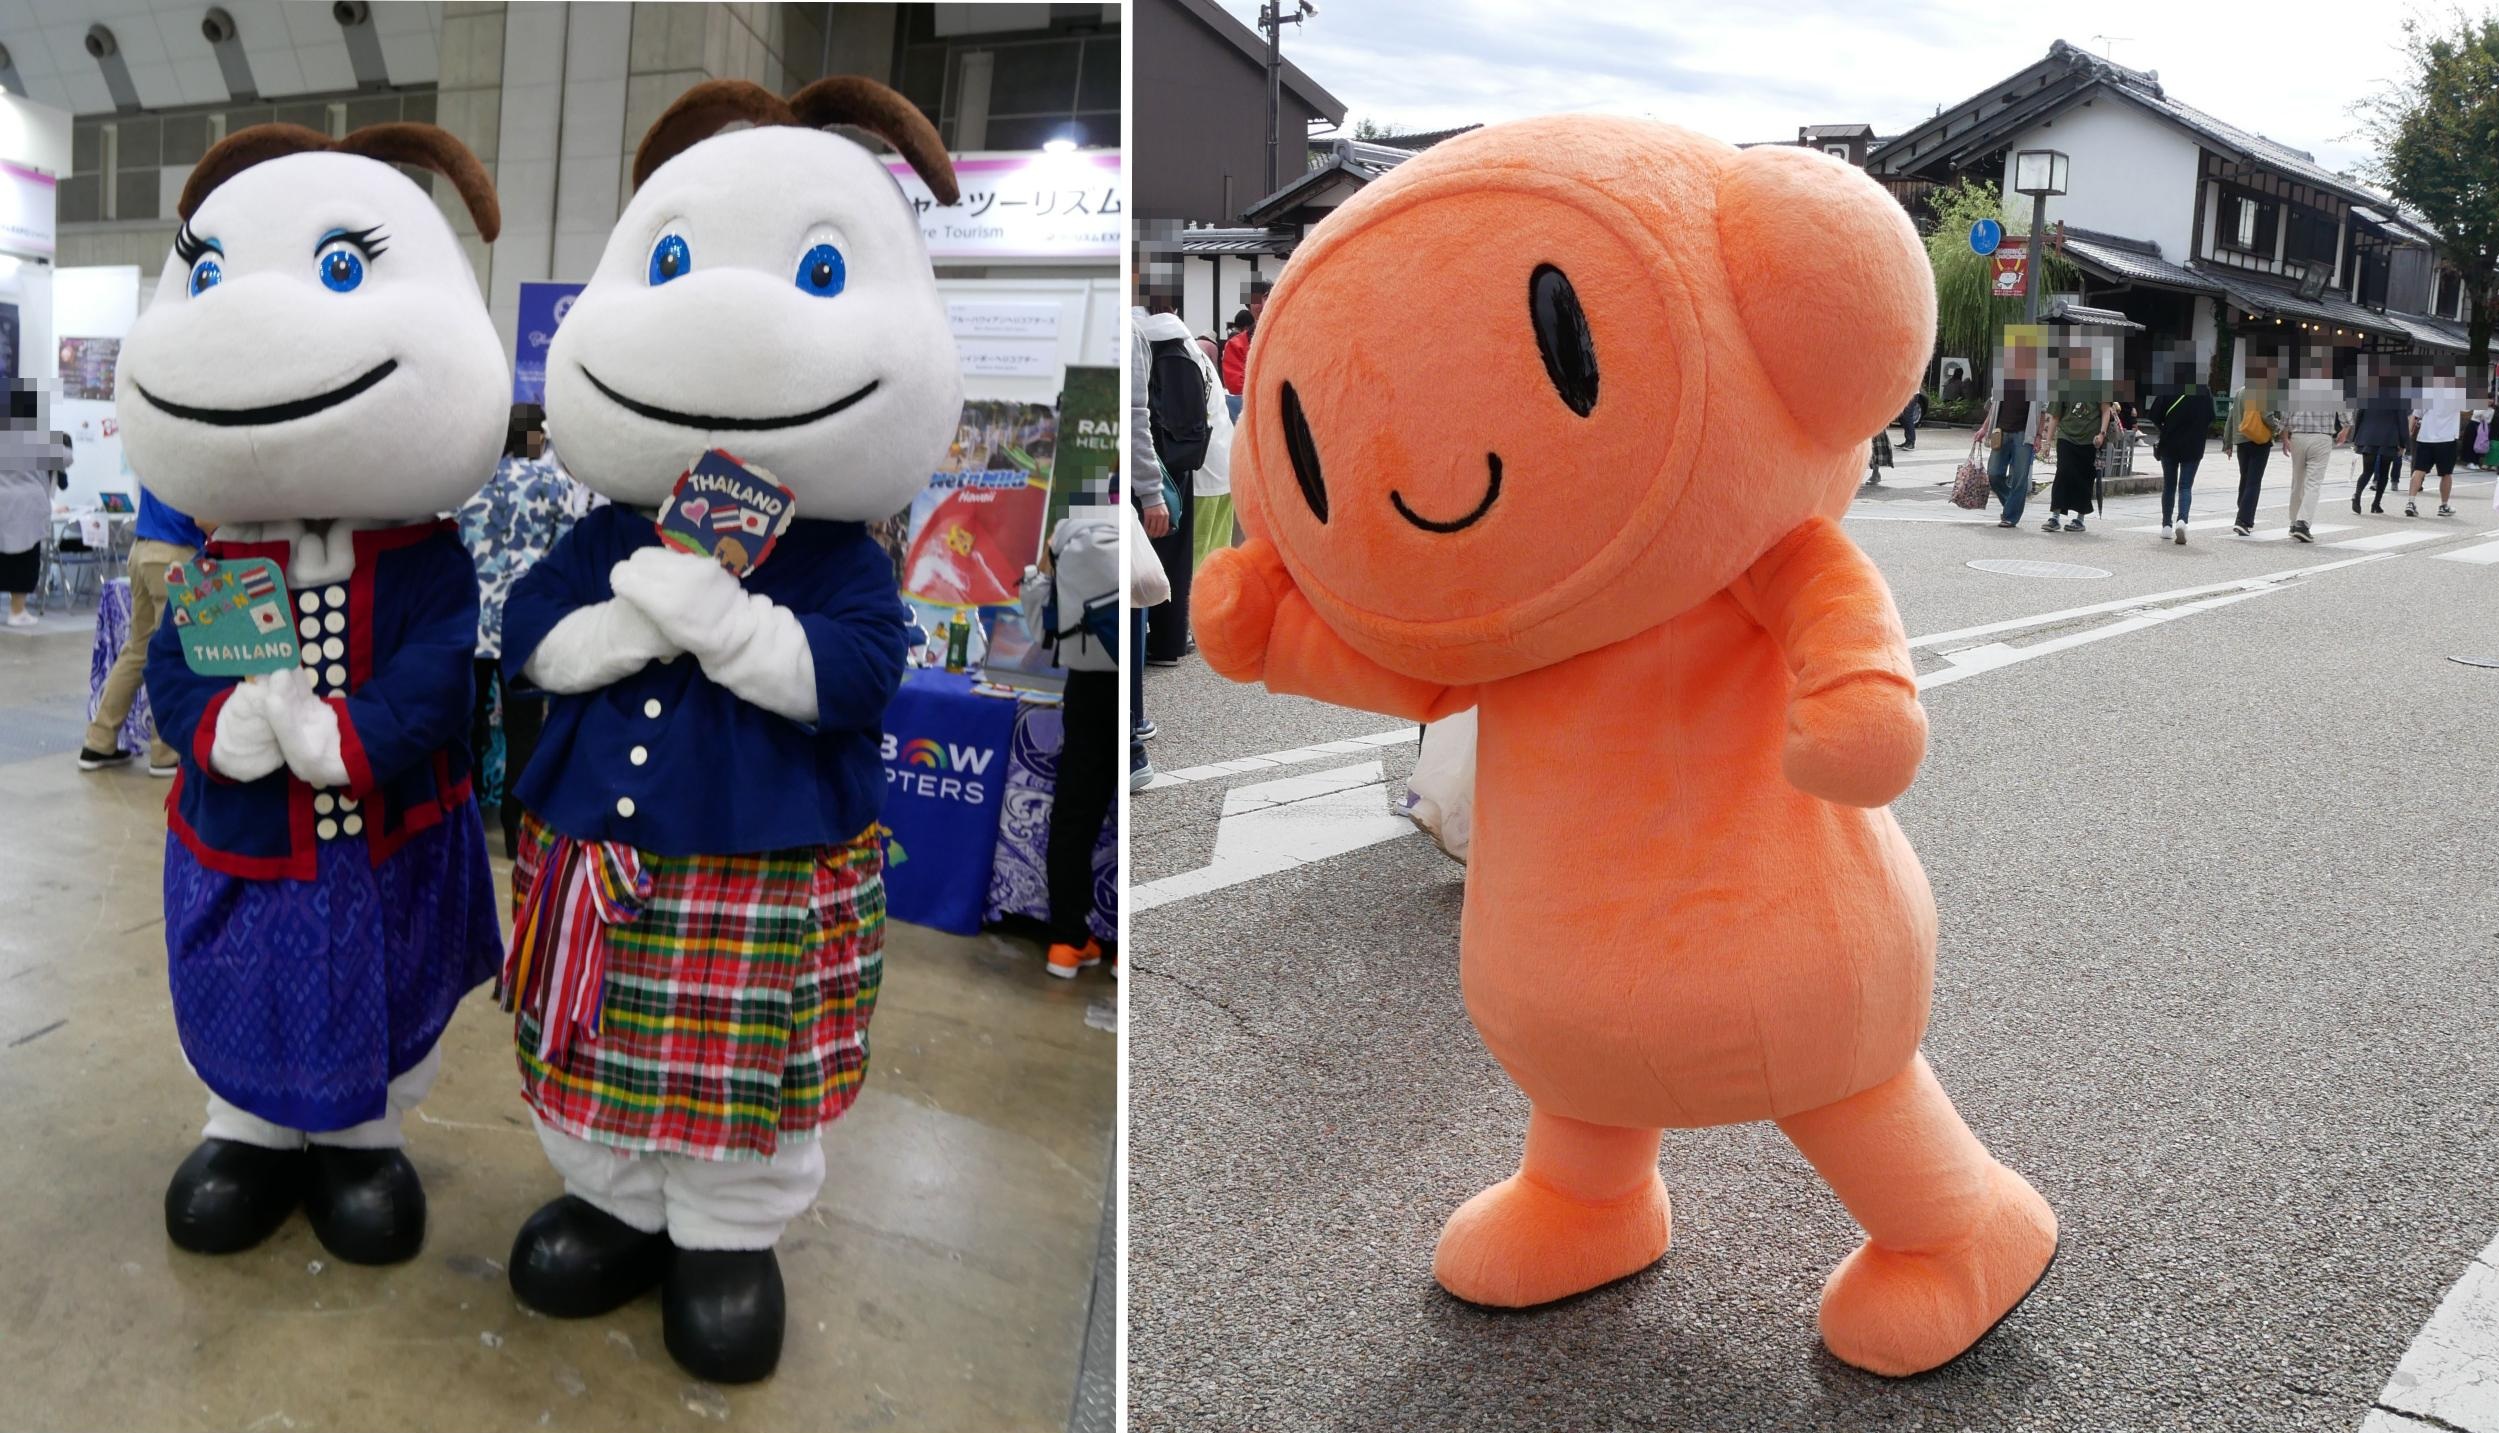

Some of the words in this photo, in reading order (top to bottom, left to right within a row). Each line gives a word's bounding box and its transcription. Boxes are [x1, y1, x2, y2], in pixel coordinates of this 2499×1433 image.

[944, 225, 1004, 240] Tourism
[688, 473, 782, 516] THAILAND
[193, 642, 293, 661] THAILAND
